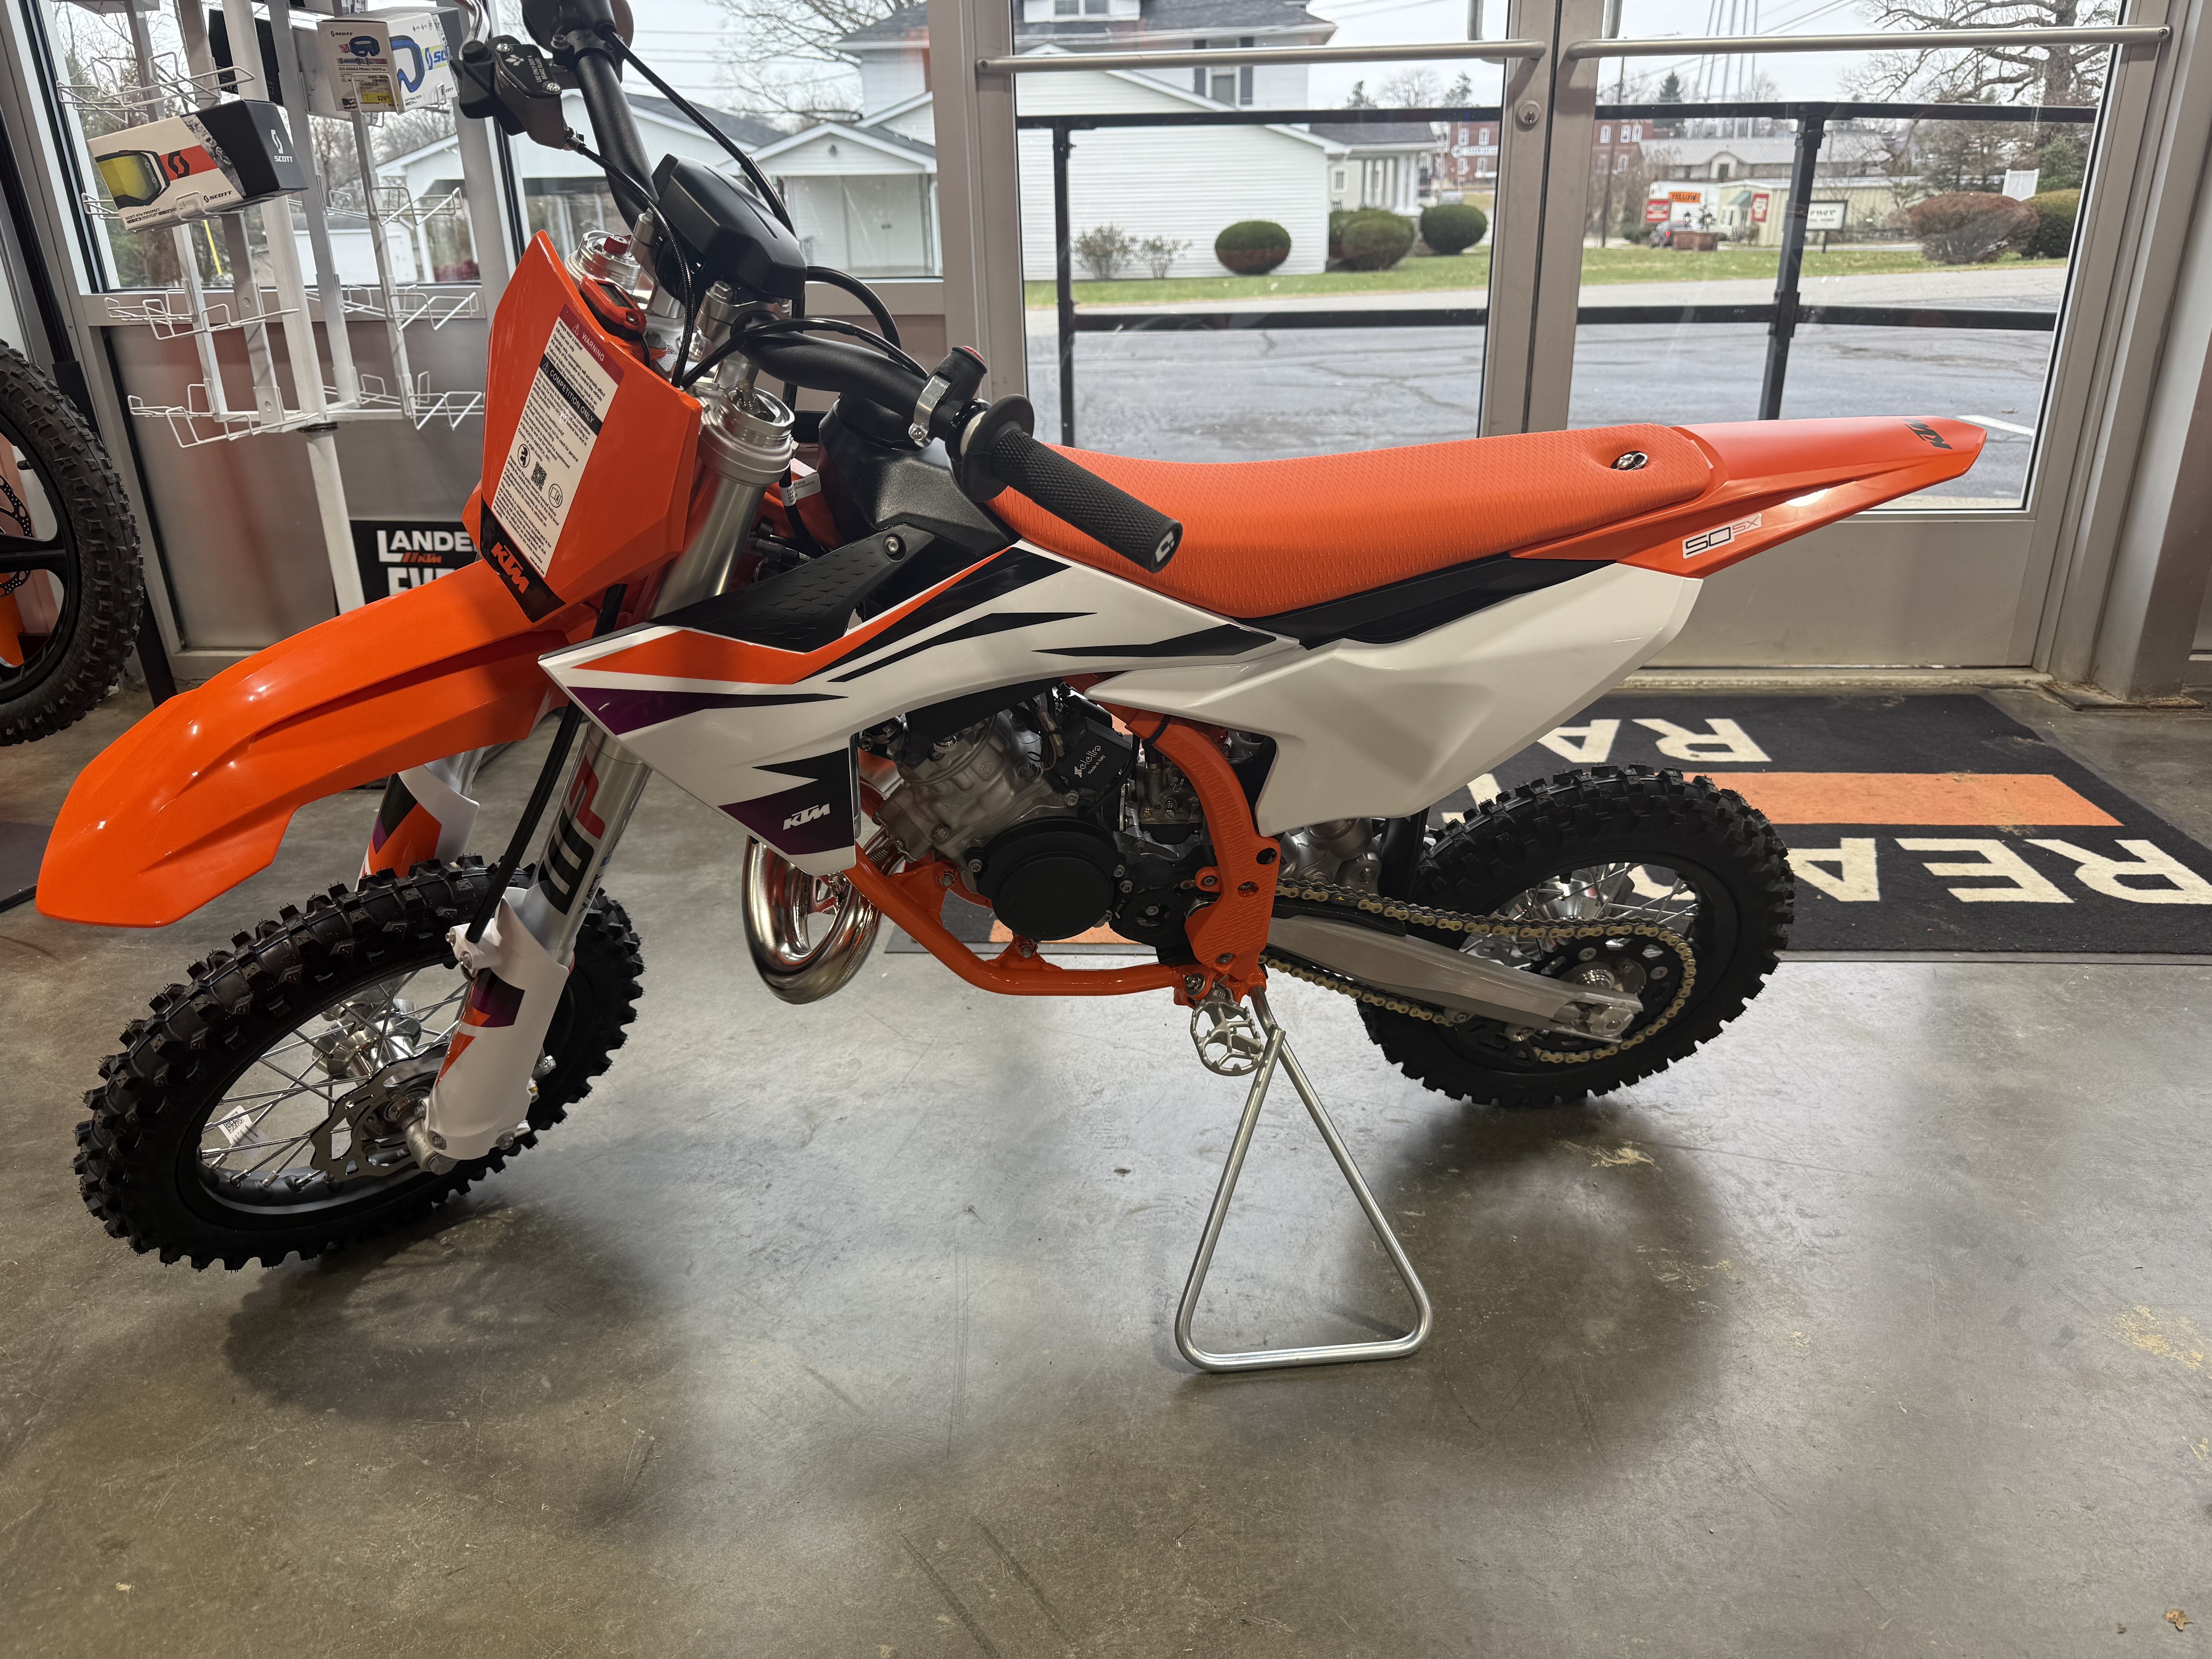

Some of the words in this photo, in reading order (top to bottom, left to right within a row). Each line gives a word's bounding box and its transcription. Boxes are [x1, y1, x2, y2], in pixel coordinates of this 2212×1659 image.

[531, 66, 539, 75] ONLY
[209, 190, 232, 201] SCOTT
[1672, 193, 1698, 201] YELLOW
[581, 332, 605, 362] WARNING
[550, 369, 580, 409] COMPETITION
[580, 405, 594, 425] ONLY
[1902, 417, 1953, 450] KTM
[376, 530, 477, 562] LANDE
[1685, 526, 1731, 555] 50
[1732, 517, 1758, 534] SX
[417, 553, 442, 563] KTM
[491, 542, 529, 594] KTM
[1087, 765, 1097, 774] Made
[782, 803, 830, 831] KTM
[538, 754, 605, 915] WP
